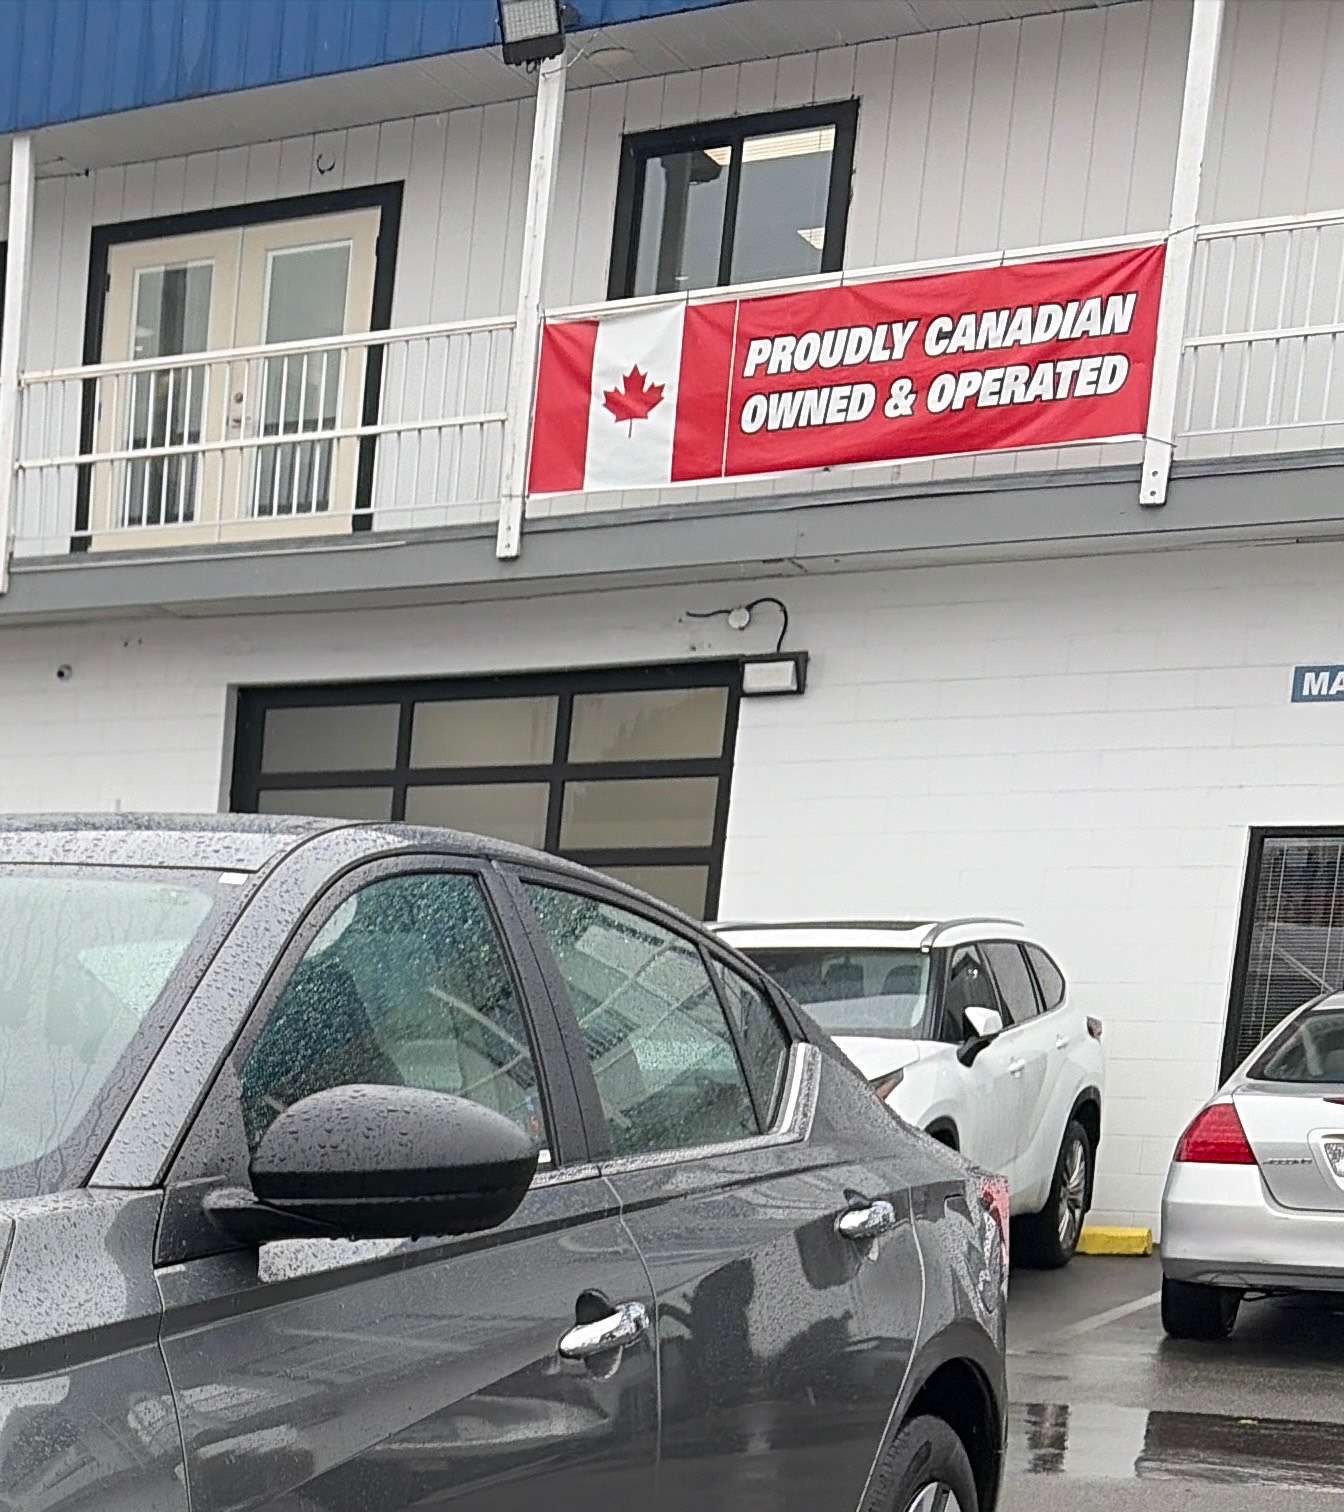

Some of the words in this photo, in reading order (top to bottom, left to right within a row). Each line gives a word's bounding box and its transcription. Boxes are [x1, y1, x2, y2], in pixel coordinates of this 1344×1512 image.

[743, 320, 918, 377] PROUDLY
[924, 294, 1137, 356] CANADIAN
[741, 382, 875, 434] OWNED
[884, 377, 915, 417] &
[926, 355, 1129, 415] OPERATED
